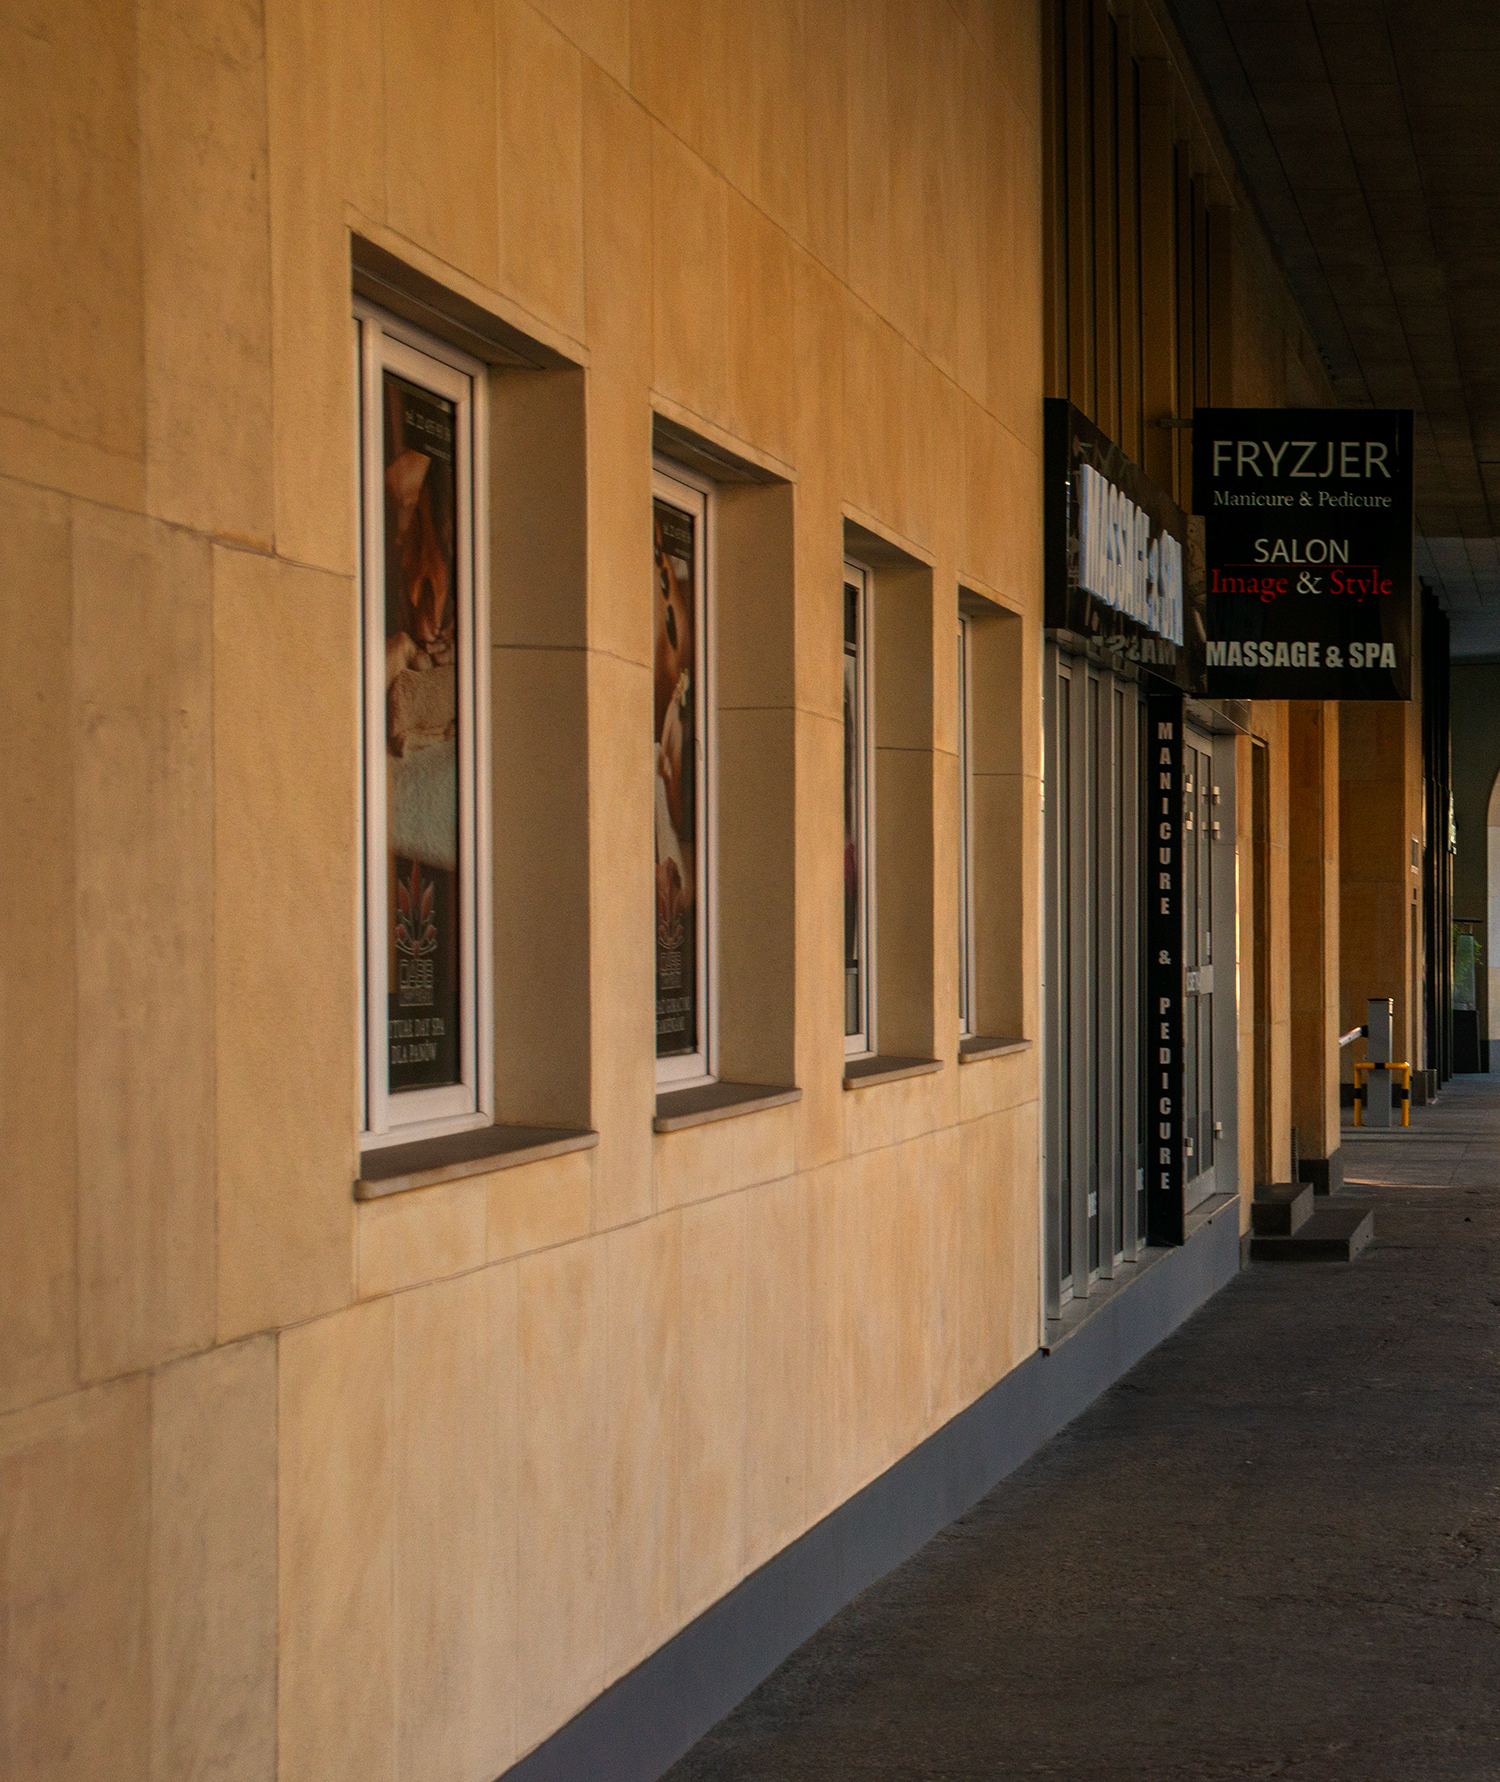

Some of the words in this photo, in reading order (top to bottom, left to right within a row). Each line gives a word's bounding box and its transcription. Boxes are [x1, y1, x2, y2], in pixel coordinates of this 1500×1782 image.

[1213, 440, 1391, 478] FRYZJER
[1213, 490, 1294, 507] Manicure
[1299, 491, 1313, 507] &
[1318, 491, 1392, 508] Pedicure
[1254, 538, 1349, 563] SALON
[1211, 569, 1289, 602] Image
[1296, 571, 1322, 594] &
[1329, 569, 1393, 602] Style
[1206, 640, 1320, 668] MASSAGE
[1325, 645, 1344, 668] &
[1348, 642, 1397, 668] SPA
[1158, 722, 1173, 916] MANICURE
[1158, 949, 1171, 965] &
[1158, 997, 1172, 1191] PEDICURE
